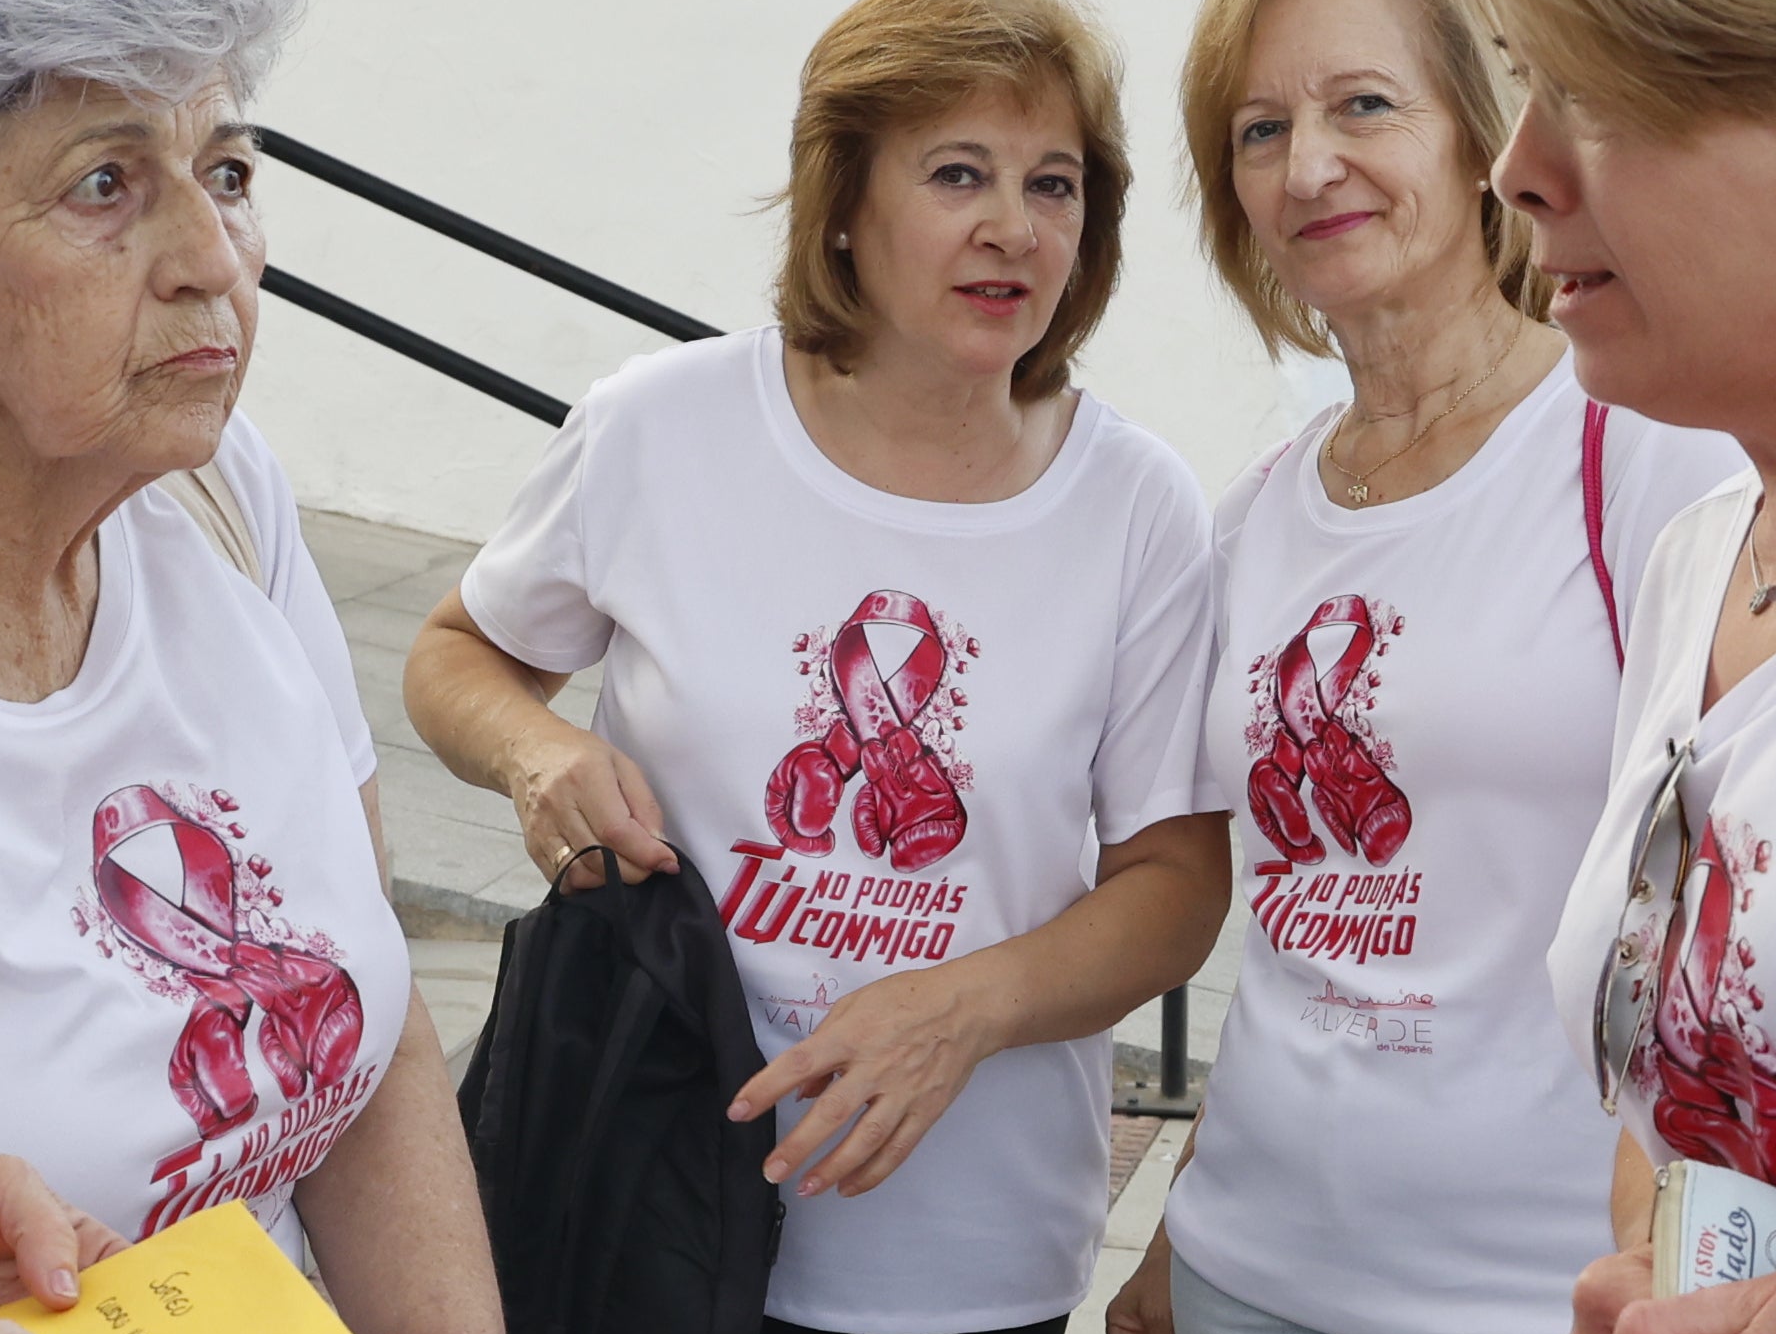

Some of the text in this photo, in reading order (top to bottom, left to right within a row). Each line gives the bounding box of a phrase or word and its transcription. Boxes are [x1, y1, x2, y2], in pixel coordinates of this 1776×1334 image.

[806, 870, 968, 916] NO PODRÁS
[1298, 866, 1422, 910] NO PODRÁS
[789, 908, 955, 964] CONMIGO
[1283, 912, 1417, 964] CONMIGO
[230, 1064, 378, 1172] NO PODRÁS
[212, 1110, 355, 1206] CONMIGO
[1717, 1207, 1755, 1282] tado
